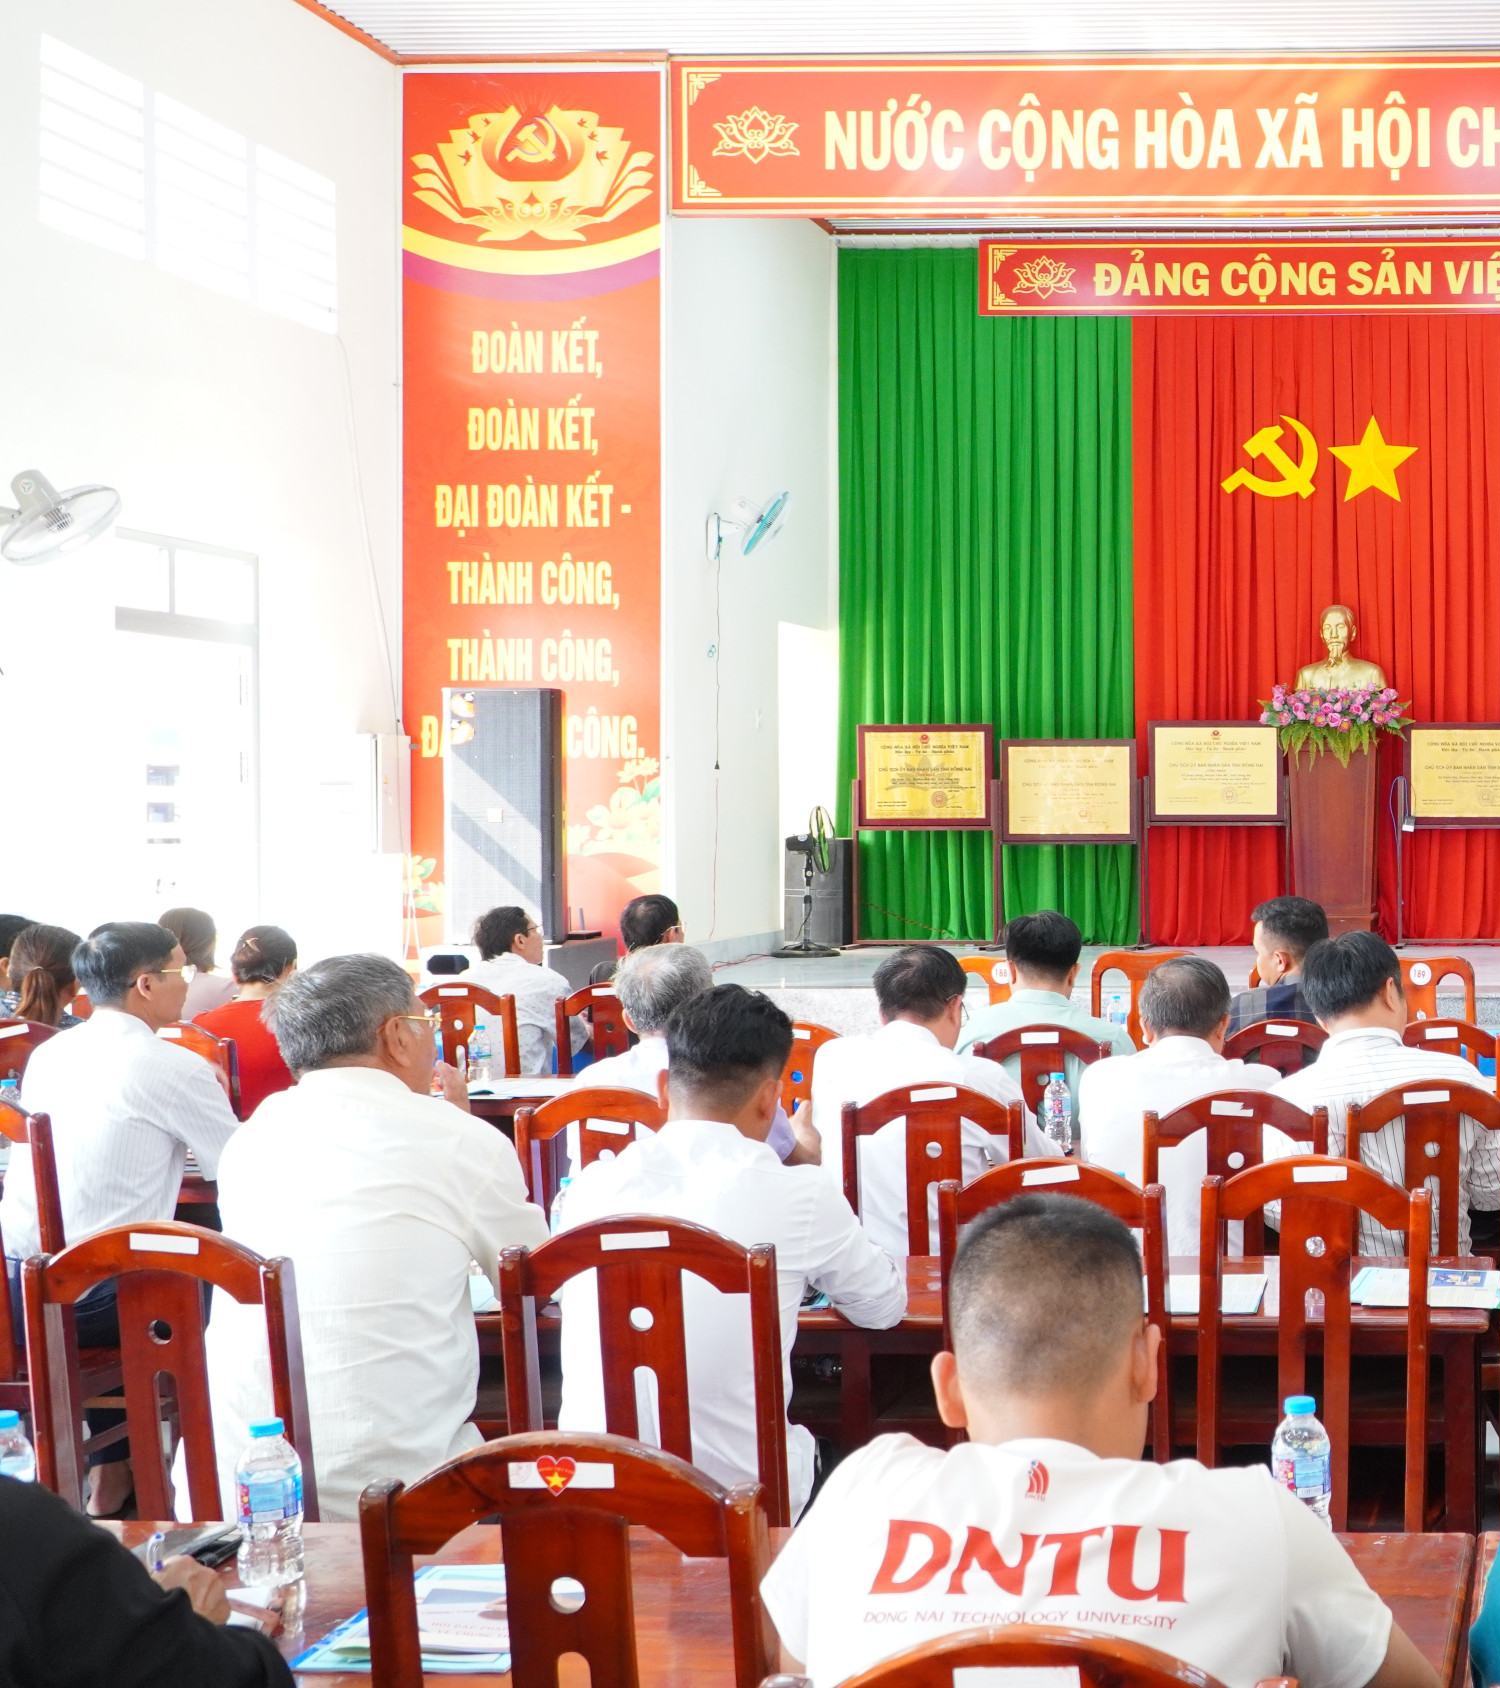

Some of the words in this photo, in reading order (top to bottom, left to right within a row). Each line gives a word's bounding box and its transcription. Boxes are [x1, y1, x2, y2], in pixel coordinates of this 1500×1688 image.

[824, 92, 966, 172] NƯỚC
[978, 93, 1119, 182] CỘNG
[1134, 91, 1242, 170] HÒA
[1255, 92, 1323, 168] XÃ
[1341, 91, 1430, 181] HỘI
[1093, 248, 1211, 298] ĐẢNG
[1220, 253, 1347, 303] CỘNG
[1355, 247, 1434, 296] SẢN
[471, 321, 544, 374] ĐOÀN
[551, 316, 603, 379] KẾT,
[467, 398, 540, 451] ĐOÀN
[547, 393, 599, 455] KẾT,
[434, 485, 479, 538] ĐẠI
[485, 475, 559, 528] ĐOÀN
[565, 470, 614, 528] KẾT
[447, 552, 533, 605] THÀNH
[540, 551, 620, 611] CÔNG,
[447, 629, 533, 682] THÀNH
[540, 628, 620, 688] CÔNG,
[566, 705, 646, 760] CÔNG.
[868, 1519, 1192, 1604] DNTU
[863, 1611, 909, 1624] DONG
[914, 1611, 945, 1623] NAI
[952, 1610, 1069, 1624] TECHNOLOGY
[1076, 1610, 1178, 1630] UNIVERSITY
